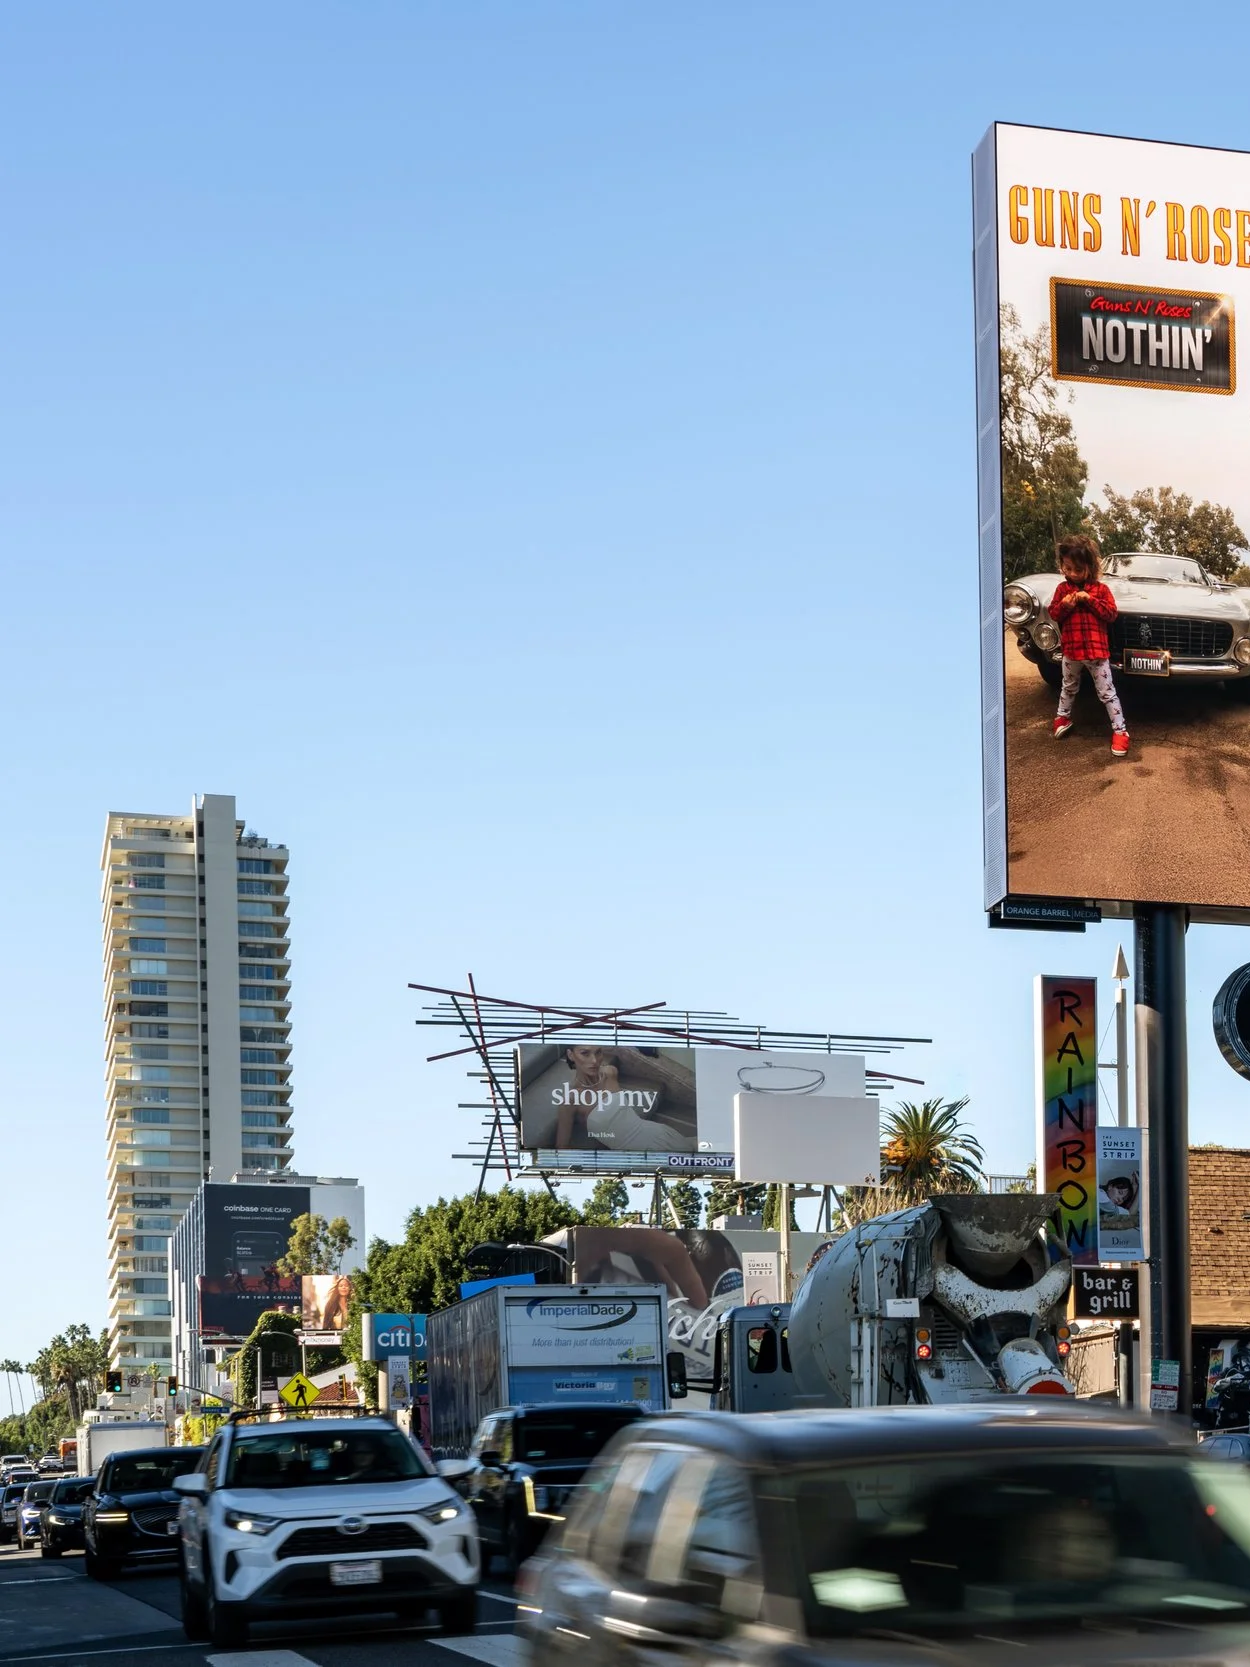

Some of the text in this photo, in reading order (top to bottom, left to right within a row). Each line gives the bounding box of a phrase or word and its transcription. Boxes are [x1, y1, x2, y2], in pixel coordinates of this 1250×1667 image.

[1009, 184, 1102, 253] GUNS
[1120, 197, 1156, 257] N'
[1090, 296, 1193, 318] Guns N' Roses
[1081, 316, 1212, 371] NOTHIN'
[1131, 657, 1164, 671] NOTHIN'
[1006, 906, 1099, 918] ORANGE BARREL MEDIA
[551, 1081, 658, 1113] shop my
[1052, 989, 1089, 1248] RAINBOW
[1102, 1140, 1135, 1148] SUNSET
[669, 1156, 733, 1167] OUTFRONT
[1103, 1151, 1136, 1159] STRIP
[224, 1204, 259, 1213] coinbase
[1111, 1236, 1130, 1246] Dior
[1082, 1271, 1133, 1291] bar &
[1089, 1290, 1132, 1315] grill
[539, 1303, 625, 1318] ImperialDade
[532, 1336, 635, 1348] More than just distribution!
